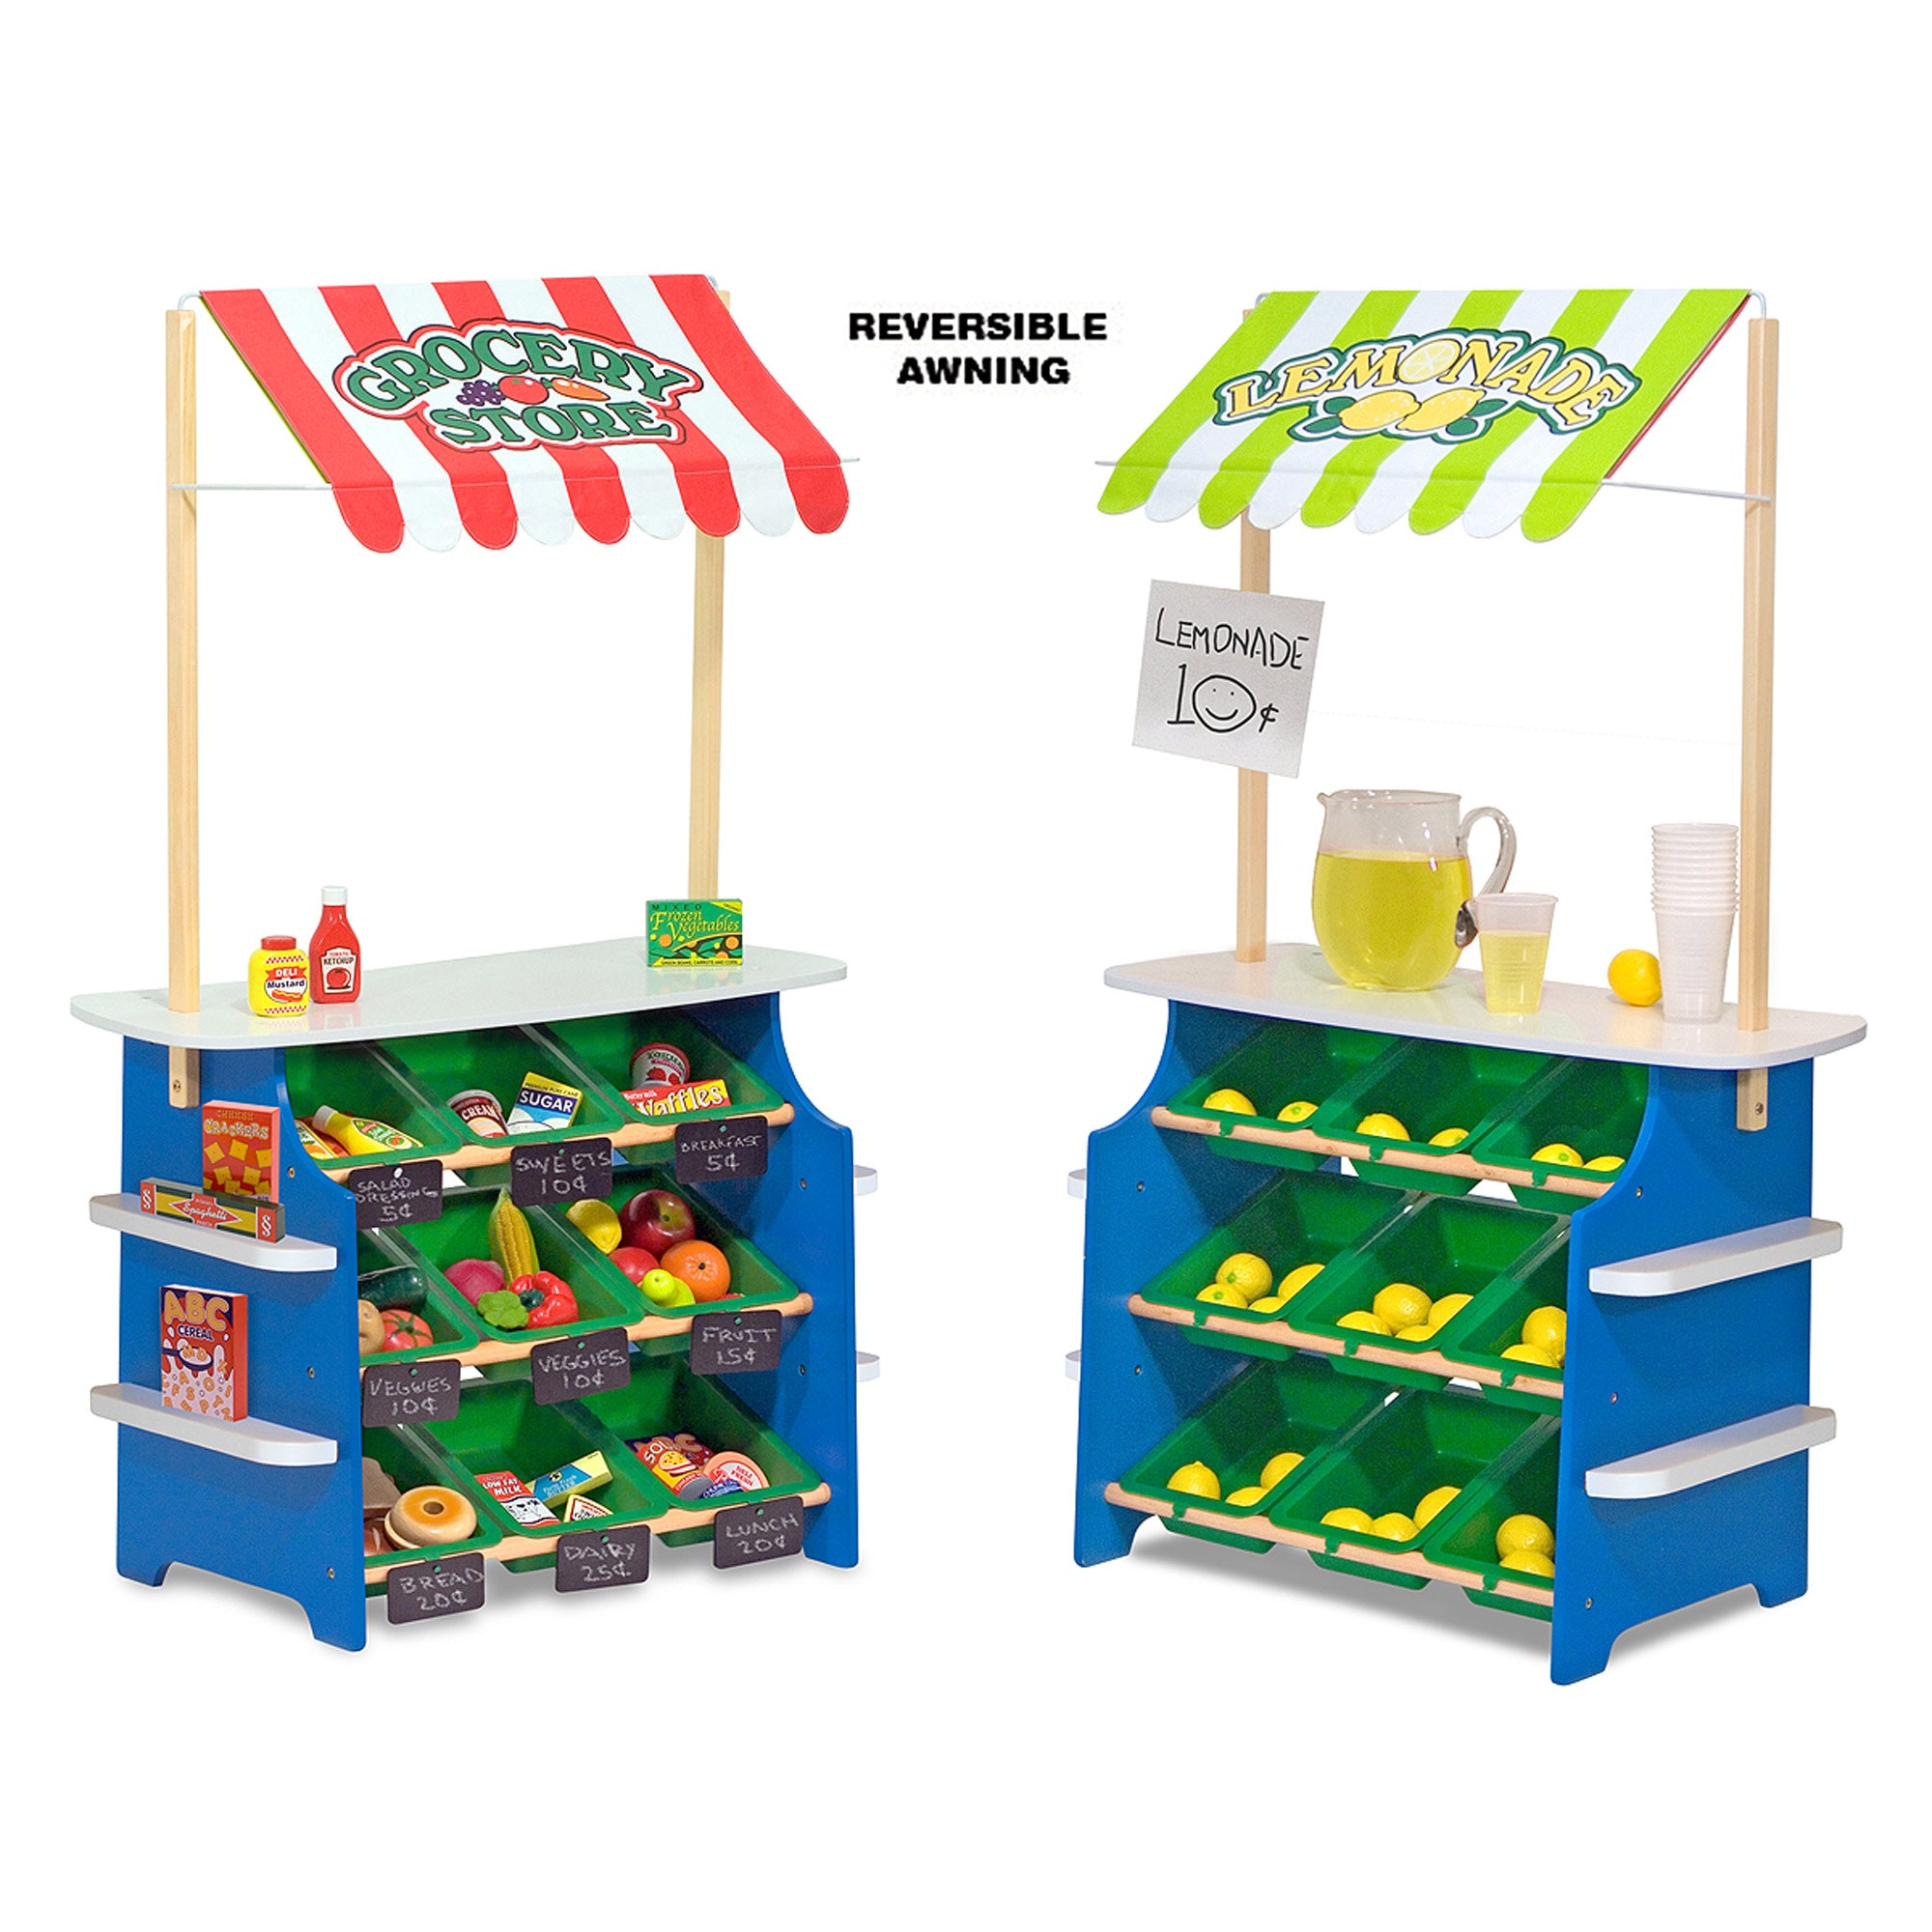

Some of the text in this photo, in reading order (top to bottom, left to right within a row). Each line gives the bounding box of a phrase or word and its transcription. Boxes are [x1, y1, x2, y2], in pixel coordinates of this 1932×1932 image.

[347, 328, 689, 411] GROCERY
[1228, 338, 1630, 425] LEMONADE
[429, 401, 671, 445] STORE
[1155, 607, 1310, 670] LEMONADE
[650, 911, 702, 930] Frozen
[667, 914, 740, 940] Vegetables
[323, 956, 355, 965] KETCHUP
[275, 967, 298, 978] DELI
[267, 980, 305, 989] Mustard
[519, 1090, 574, 1114] SUGAR
[204, 1118, 270, 1141] CRACKERS
[356, 1177, 412, 1194] SALAD
[163, 1290, 230, 1332] ABC
[177, 1323, 215, 1341] CEREAL
[701, 1325, 778, 1344] FRUIT
[538, 1348, 627, 1373] VEGGIES
[494, 1486, 523, 1496] MILK
[725, 1513, 800, 1538] LUNCH
[563, 1543, 637, 1561] DAIRY
[399, 1567, 484, 1594] BREAD
